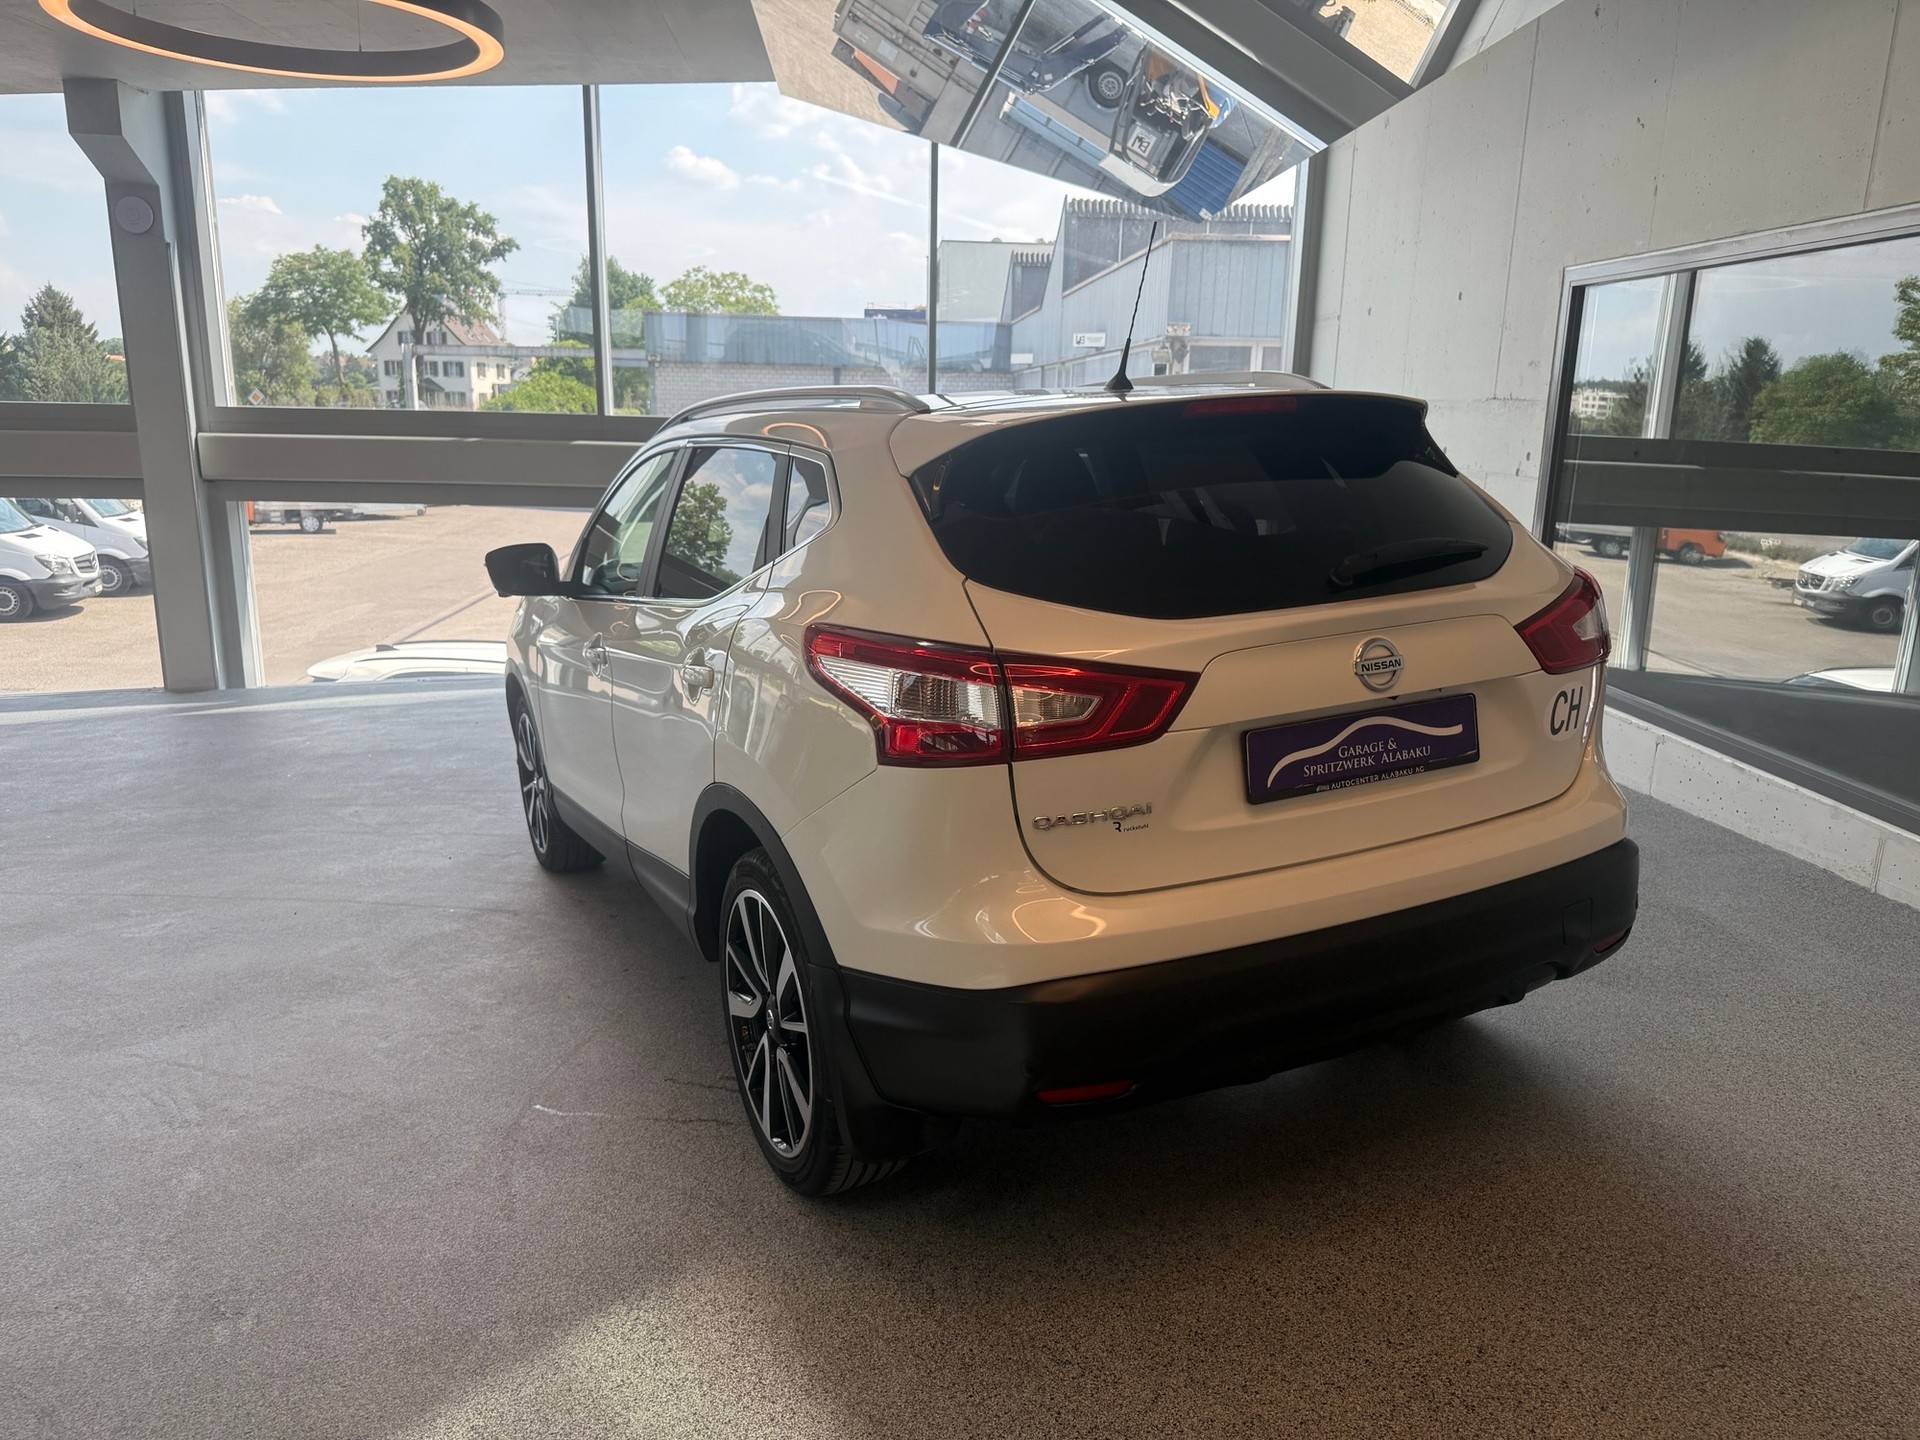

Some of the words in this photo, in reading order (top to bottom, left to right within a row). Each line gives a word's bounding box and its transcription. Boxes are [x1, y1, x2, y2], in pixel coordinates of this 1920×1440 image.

[1360, 658, 1402, 673] NISSAN
[1550, 686, 1584, 736] CH
[1303, 754, 1376, 778] SPRITZWERK
[1381, 745, 1432, 764] ALABAKU
[1338, 740, 1385, 759] GARAGE
[1387, 737, 1398, 750] &
[1331, 774, 1380, 790] AUTOCENTER
[1381, 767, 1414, 781] ALABAKU
[1415, 765, 1425, 774] AG
[1031, 801, 1153, 832] QASHQAI
